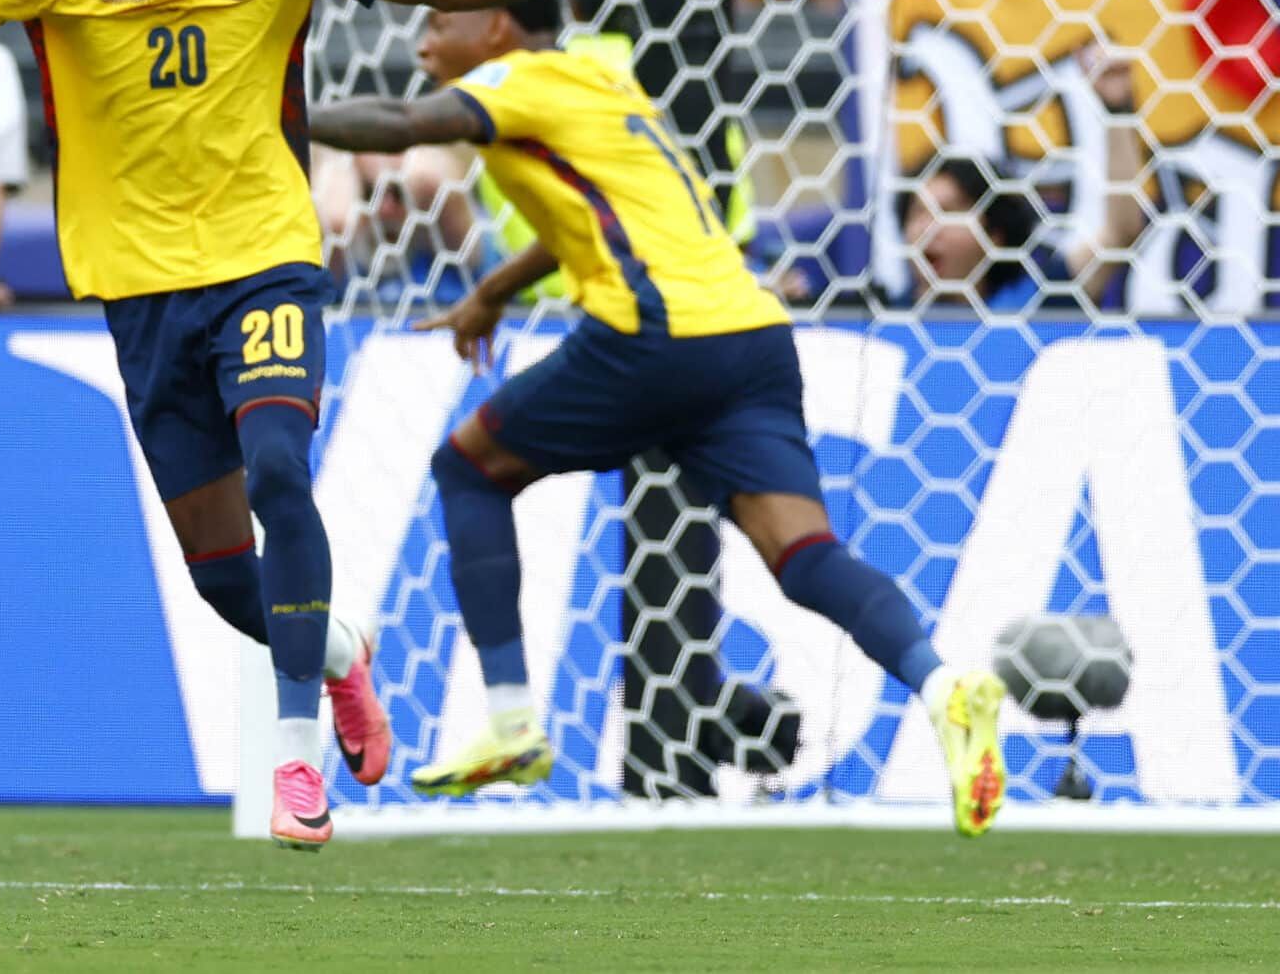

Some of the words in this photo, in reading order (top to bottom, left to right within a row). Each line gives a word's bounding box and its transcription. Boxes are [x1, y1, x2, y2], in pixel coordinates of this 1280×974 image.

[148, 24, 207, 89] 20
[241, 303, 304, 364] 20
[237, 363, 307, 385] marathon
